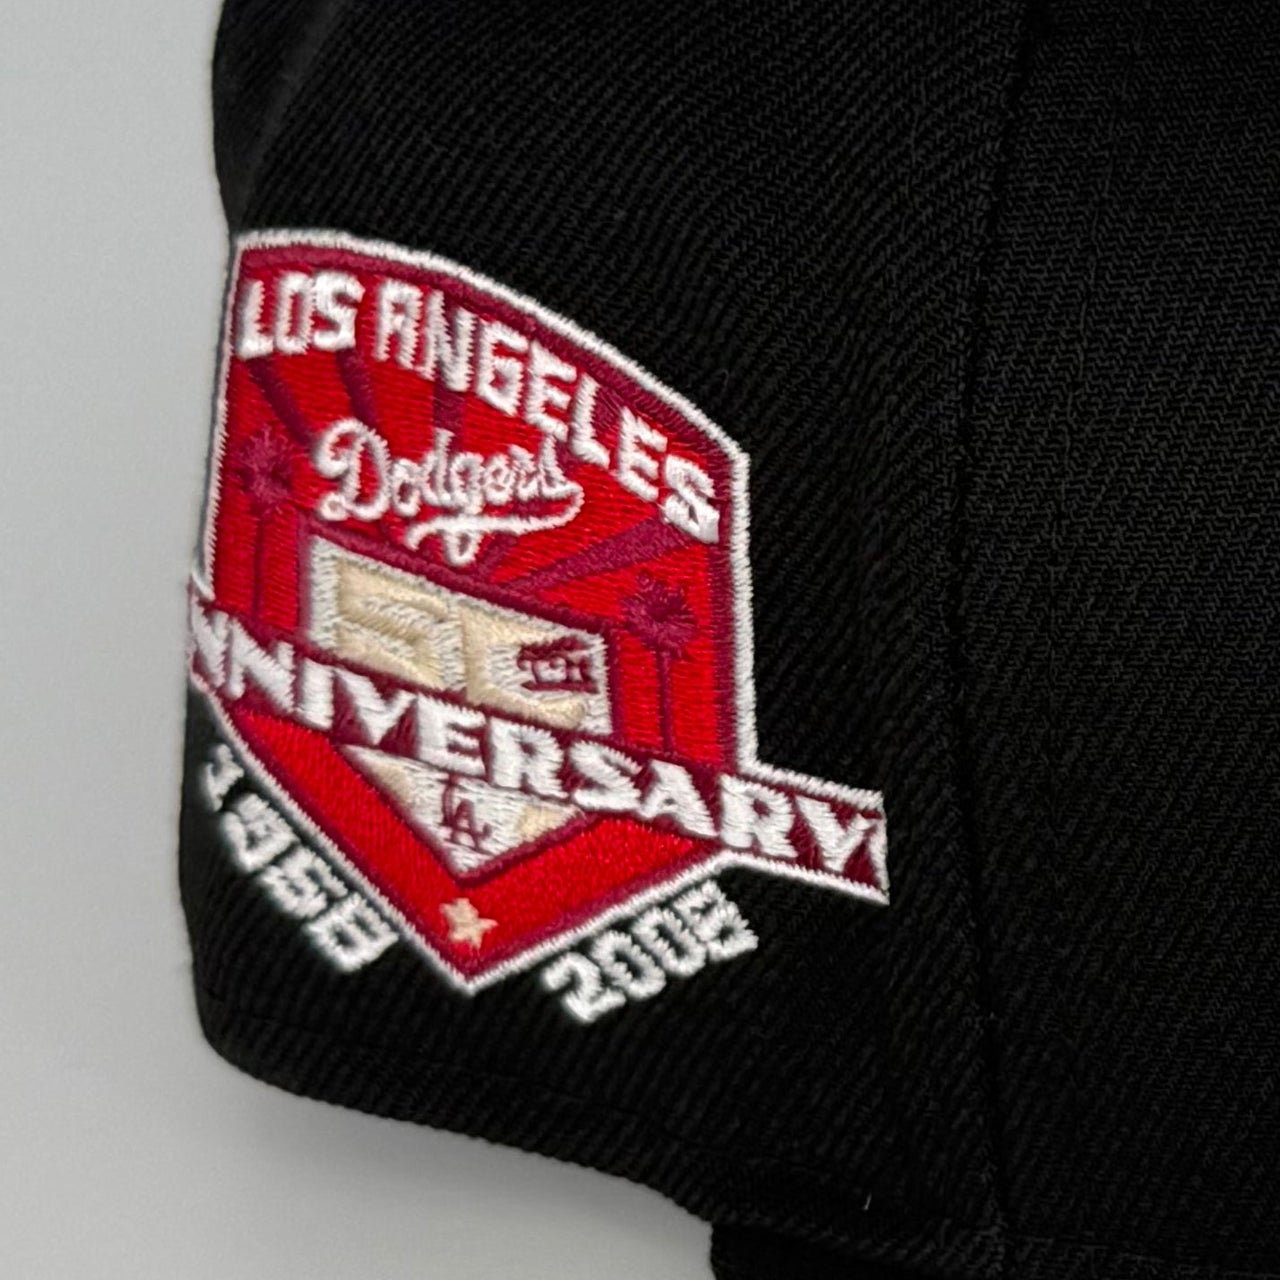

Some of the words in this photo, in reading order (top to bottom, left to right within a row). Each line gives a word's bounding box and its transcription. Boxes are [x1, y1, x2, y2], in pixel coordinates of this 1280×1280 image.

[238, 271, 365, 360] LOS
[376, 277, 720, 544] ANGELES
[312, 417, 584, 565] Dodgers
[186, 597, 872, 872] NNIVERSARY
[202, 743, 399, 971] 1958
[543, 879, 759, 1024] 2008
